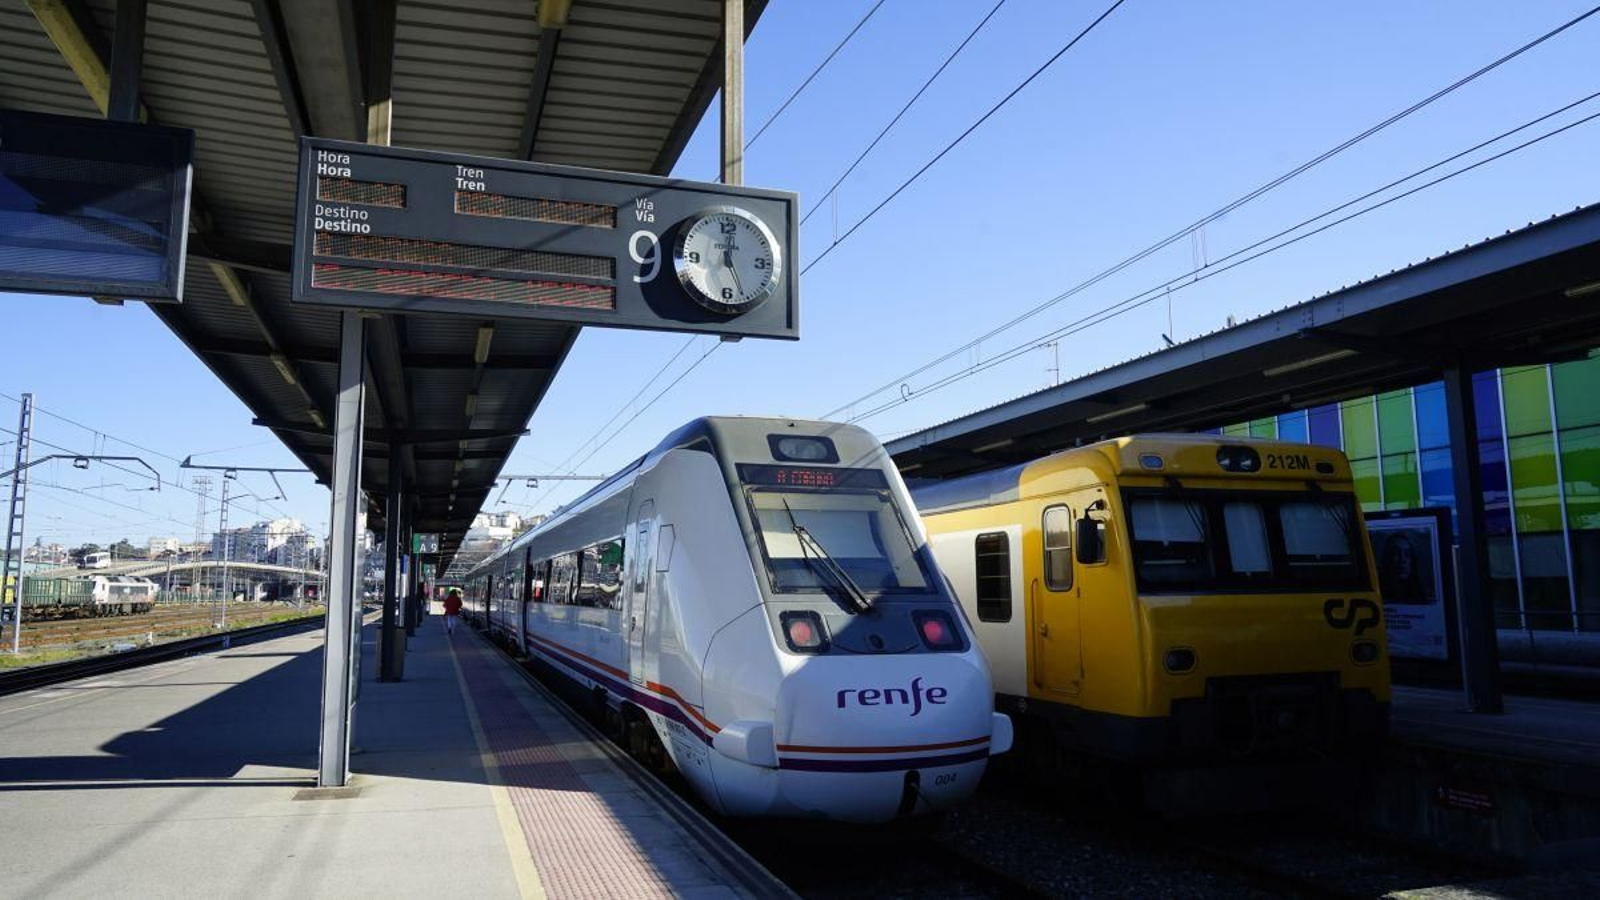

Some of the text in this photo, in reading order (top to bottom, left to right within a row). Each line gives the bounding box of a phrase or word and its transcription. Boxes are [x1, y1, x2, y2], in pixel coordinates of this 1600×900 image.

[317, 150, 350, 164] Hora
[317, 163, 351, 177] Hora
[456, 165, 484, 179] Tren
[455, 178, 486, 191] Tren
[635, 197, 654, 210] Vía
[315, 204, 369, 220] Destino
[635, 210, 655, 223] Vía
[314, 217, 371, 234] Destino
[719, 222, 737, 234] 12
[628, 229, 662, 283] 9
[688, 251, 700, 264] 9
[754, 257, 766, 270] 3
[721, 287, 733, 300] 6
[1267, 454, 1311, 470] 212M
[420, 543, 437, 552] A 9
[837, 677, 948, 717] renfe
